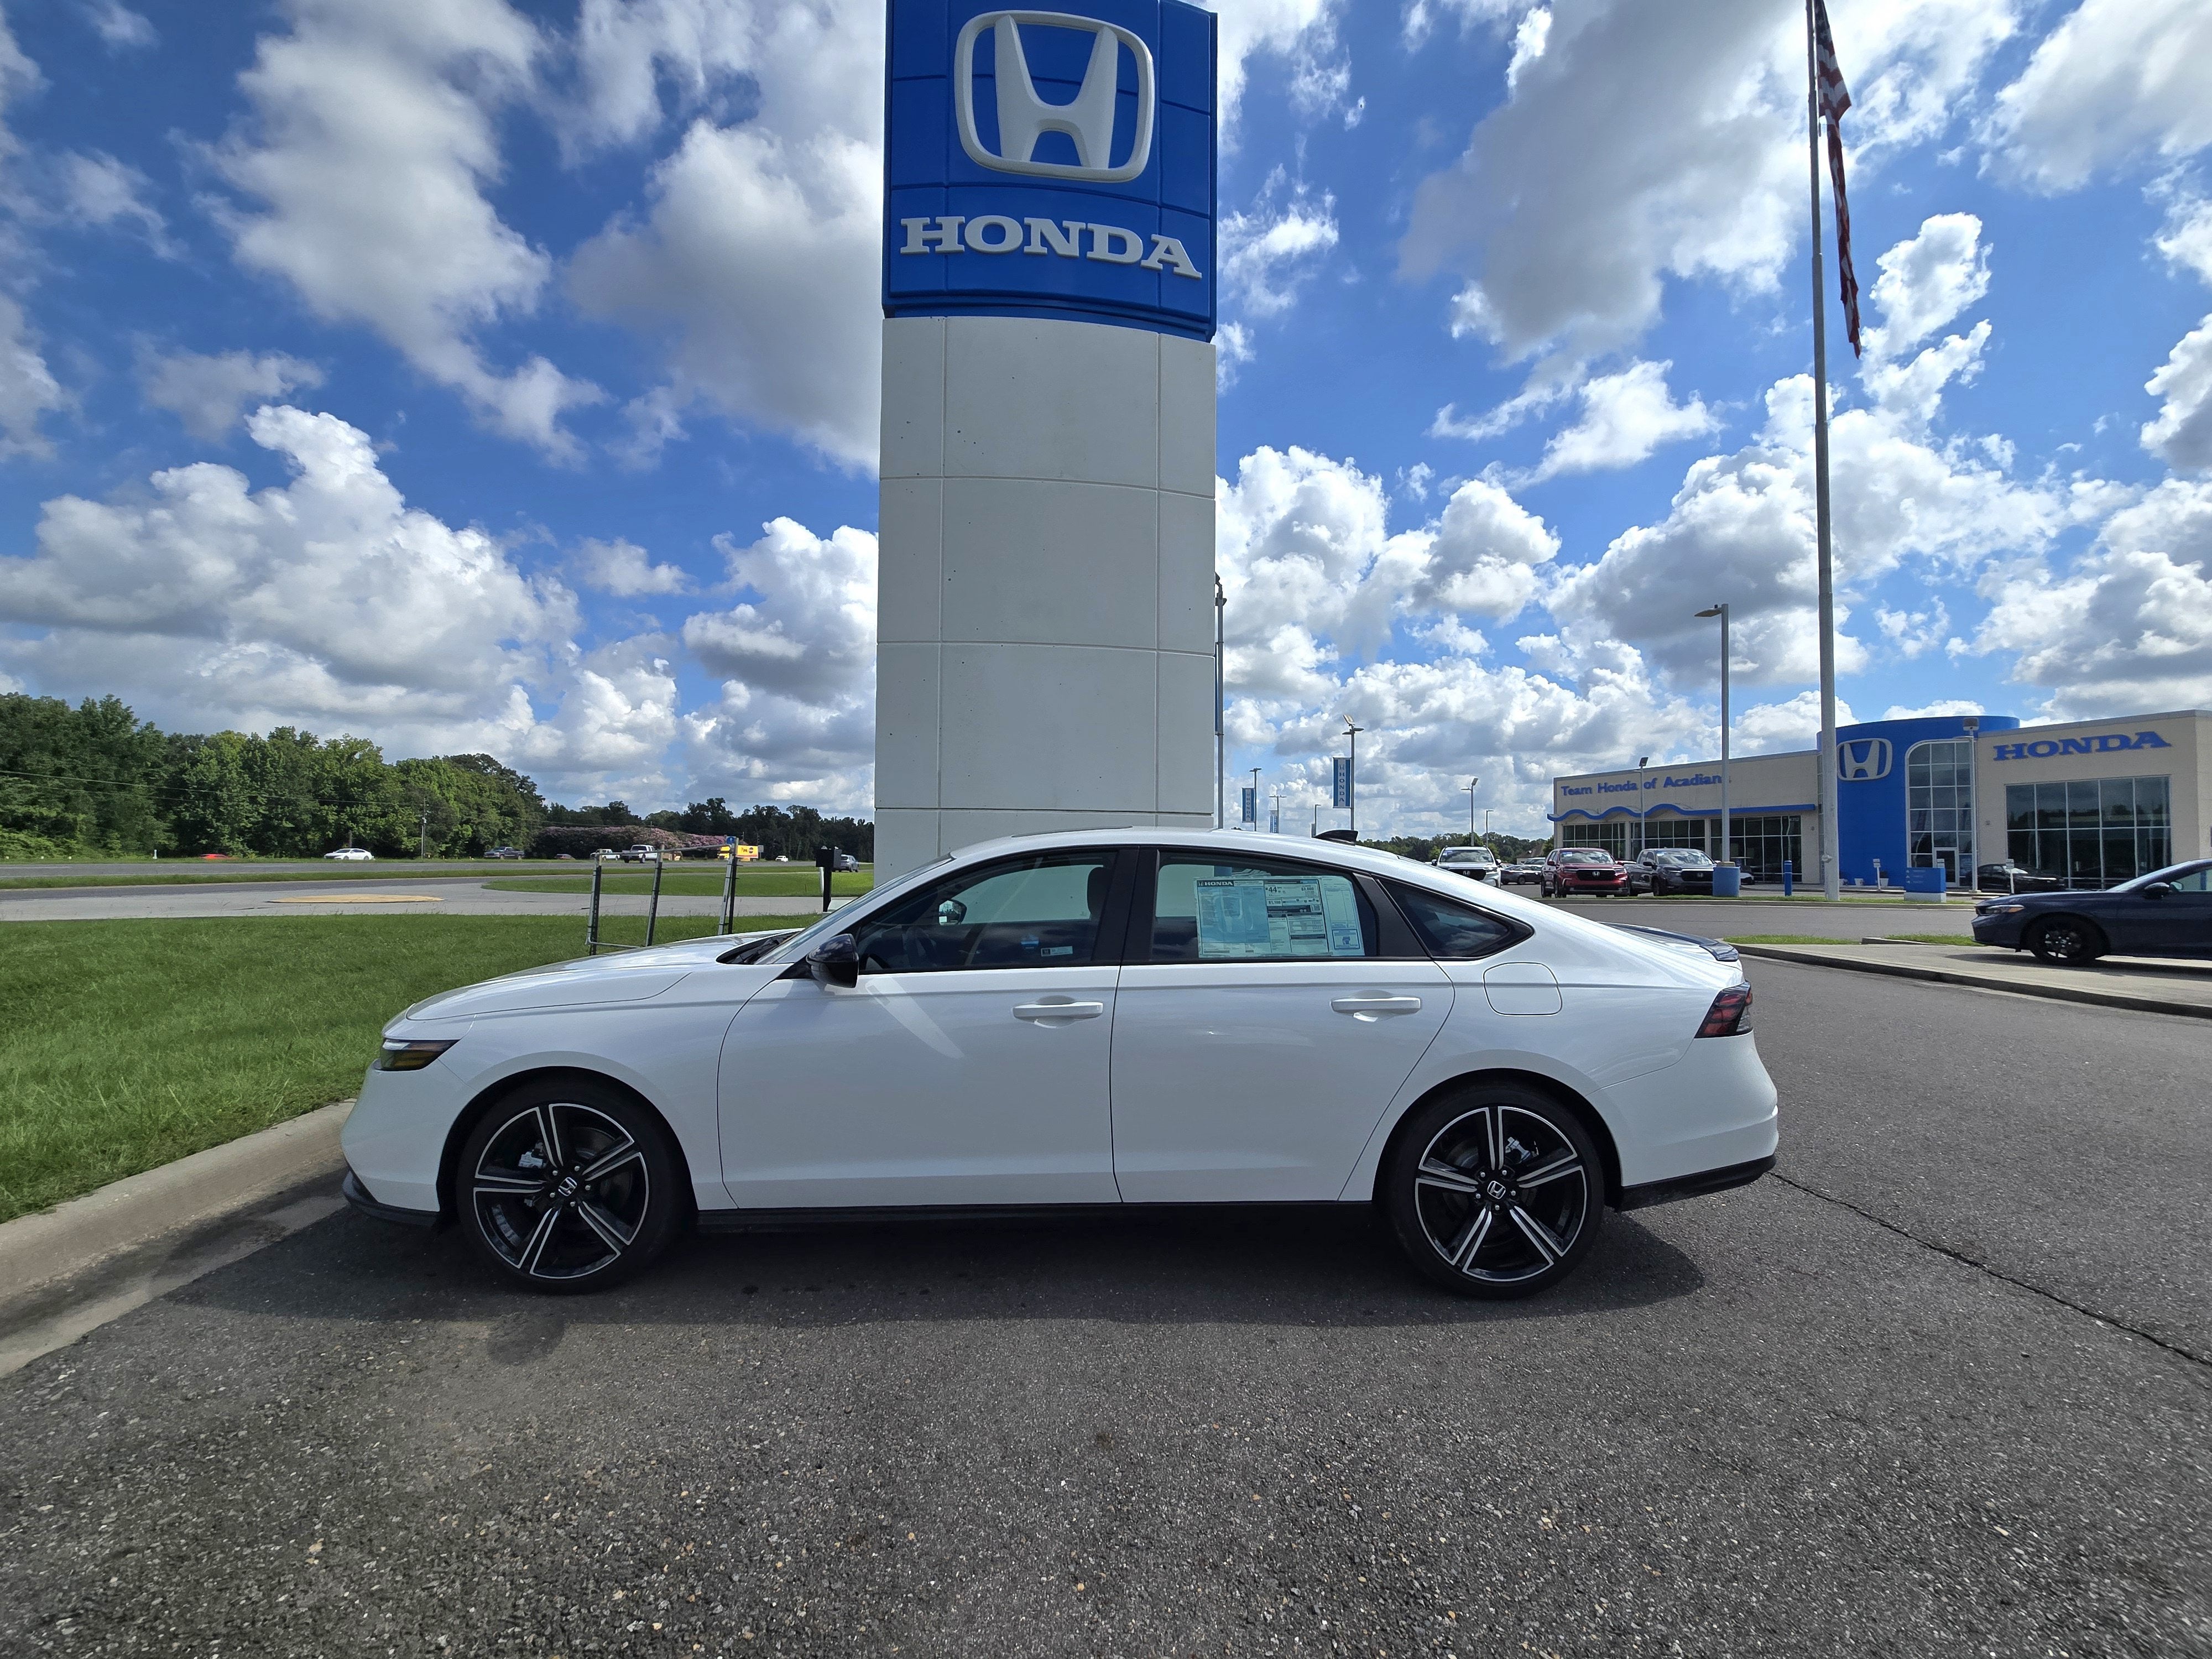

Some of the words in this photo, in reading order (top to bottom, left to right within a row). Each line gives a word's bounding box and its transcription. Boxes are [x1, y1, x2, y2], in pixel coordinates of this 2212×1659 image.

[900, 215, 1202, 279] HONDA
[1993, 731, 2172, 761] HONDA
[1561, 785, 1593, 796] Team
[1597, 780, 1638, 794] Honda
[1644, 778, 1658, 790] of
[1663, 774, 1732, 788] Acadian
